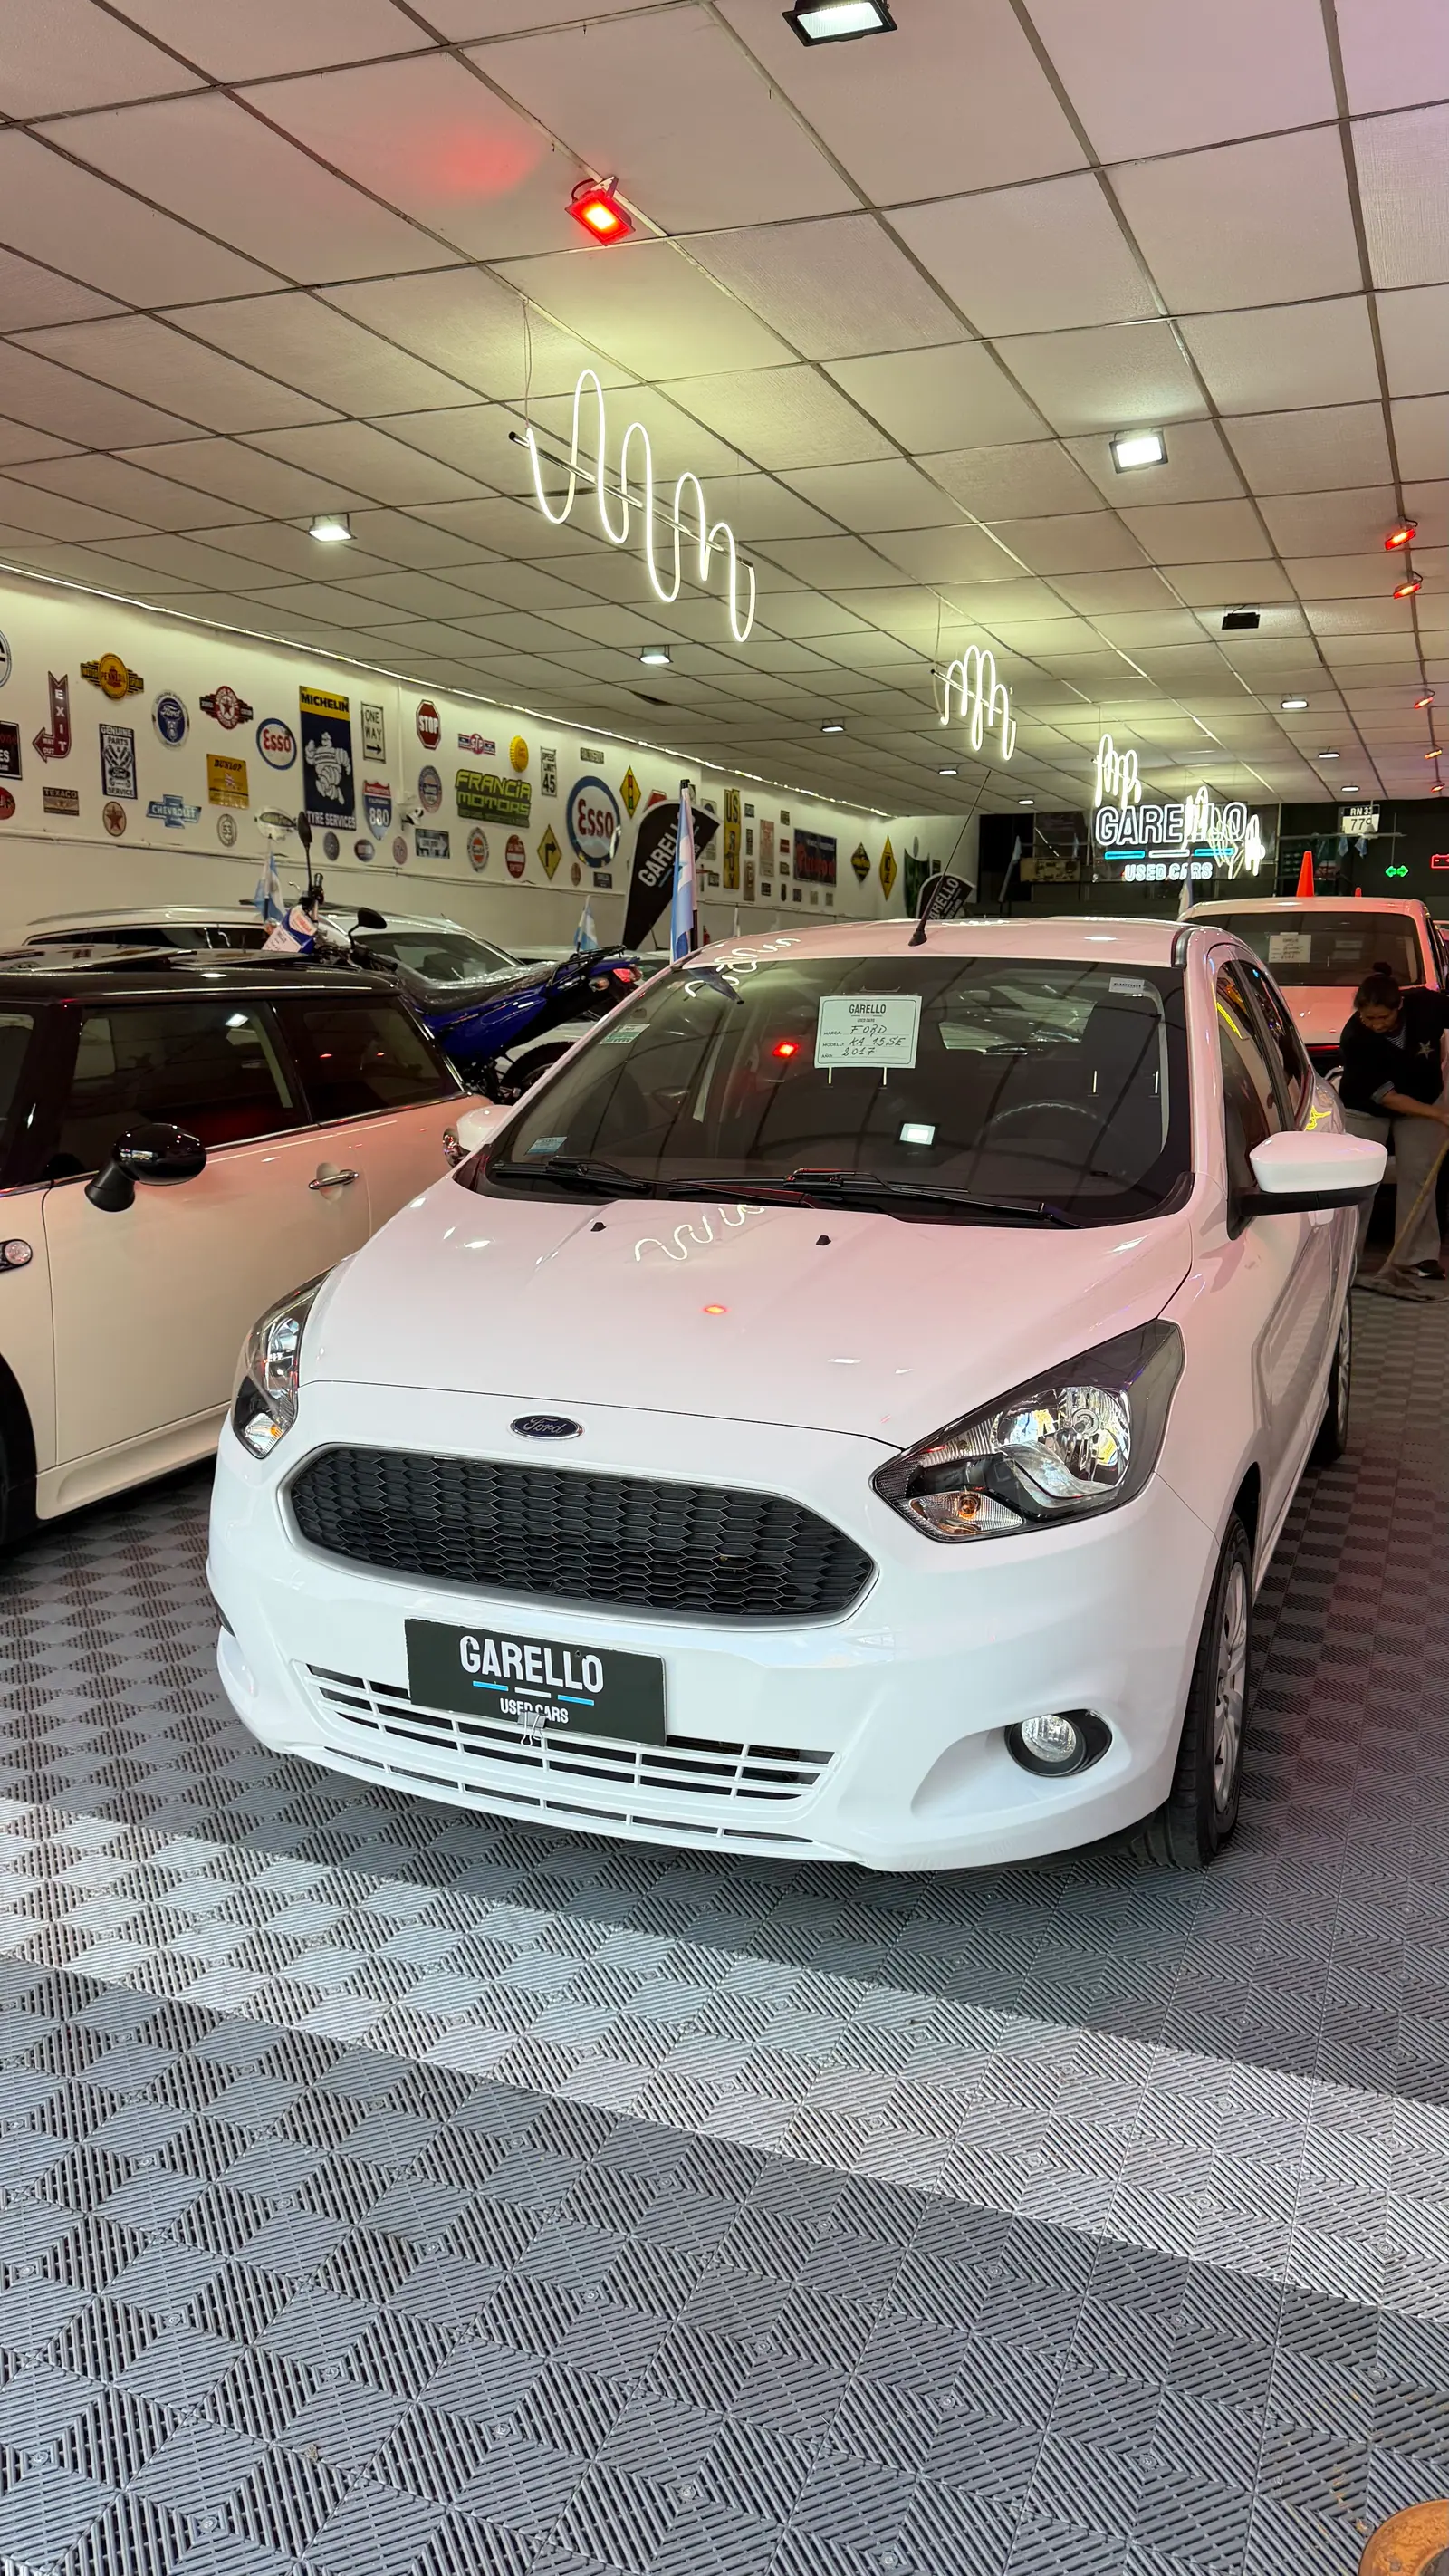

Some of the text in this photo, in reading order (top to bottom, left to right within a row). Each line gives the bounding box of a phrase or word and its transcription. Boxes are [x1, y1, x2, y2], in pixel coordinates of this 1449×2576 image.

[301, 693, 350, 713] MICHELIN
[54, 688, 67, 752] EXIT
[365, 710, 380, 724] ONE
[419, 715, 439, 734] STOP
[101, 726, 132, 736] GENUINE
[365, 726, 381, 741] WAY
[108, 736, 129, 746] PARTS
[214, 759, 242, 772] DUNLOP
[543, 773, 555, 793] 45
[44, 789, 77, 798] TEXACO
[107, 787, 133, 796] SERVICE
[151, 804, 196, 817] CHEVROLET
[456, 792, 530, 815] MOTORS
[725, 792, 739, 823] US
[306, 811, 324, 824] TYRE
[369, 808, 389, 826] 880
[1350, 807, 1362, 816] RN
[325, 814, 357, 829] SERVICES
[1124, 863, 1167, 882] USED
[927, 878, 960, 920] ARELLO
[849, 1004, 886, 1014] GARELLO
[850, 1024, 887, 1037] FORD
[849, 1037, 865, 1046] KA
[841, 1047, 876, 1057] 2017
[523, 1417, 567, 1433] Ford
[459, 1635, 604, 1693] GARELLO
[500, 1697, 570, 1724] USED CARS
